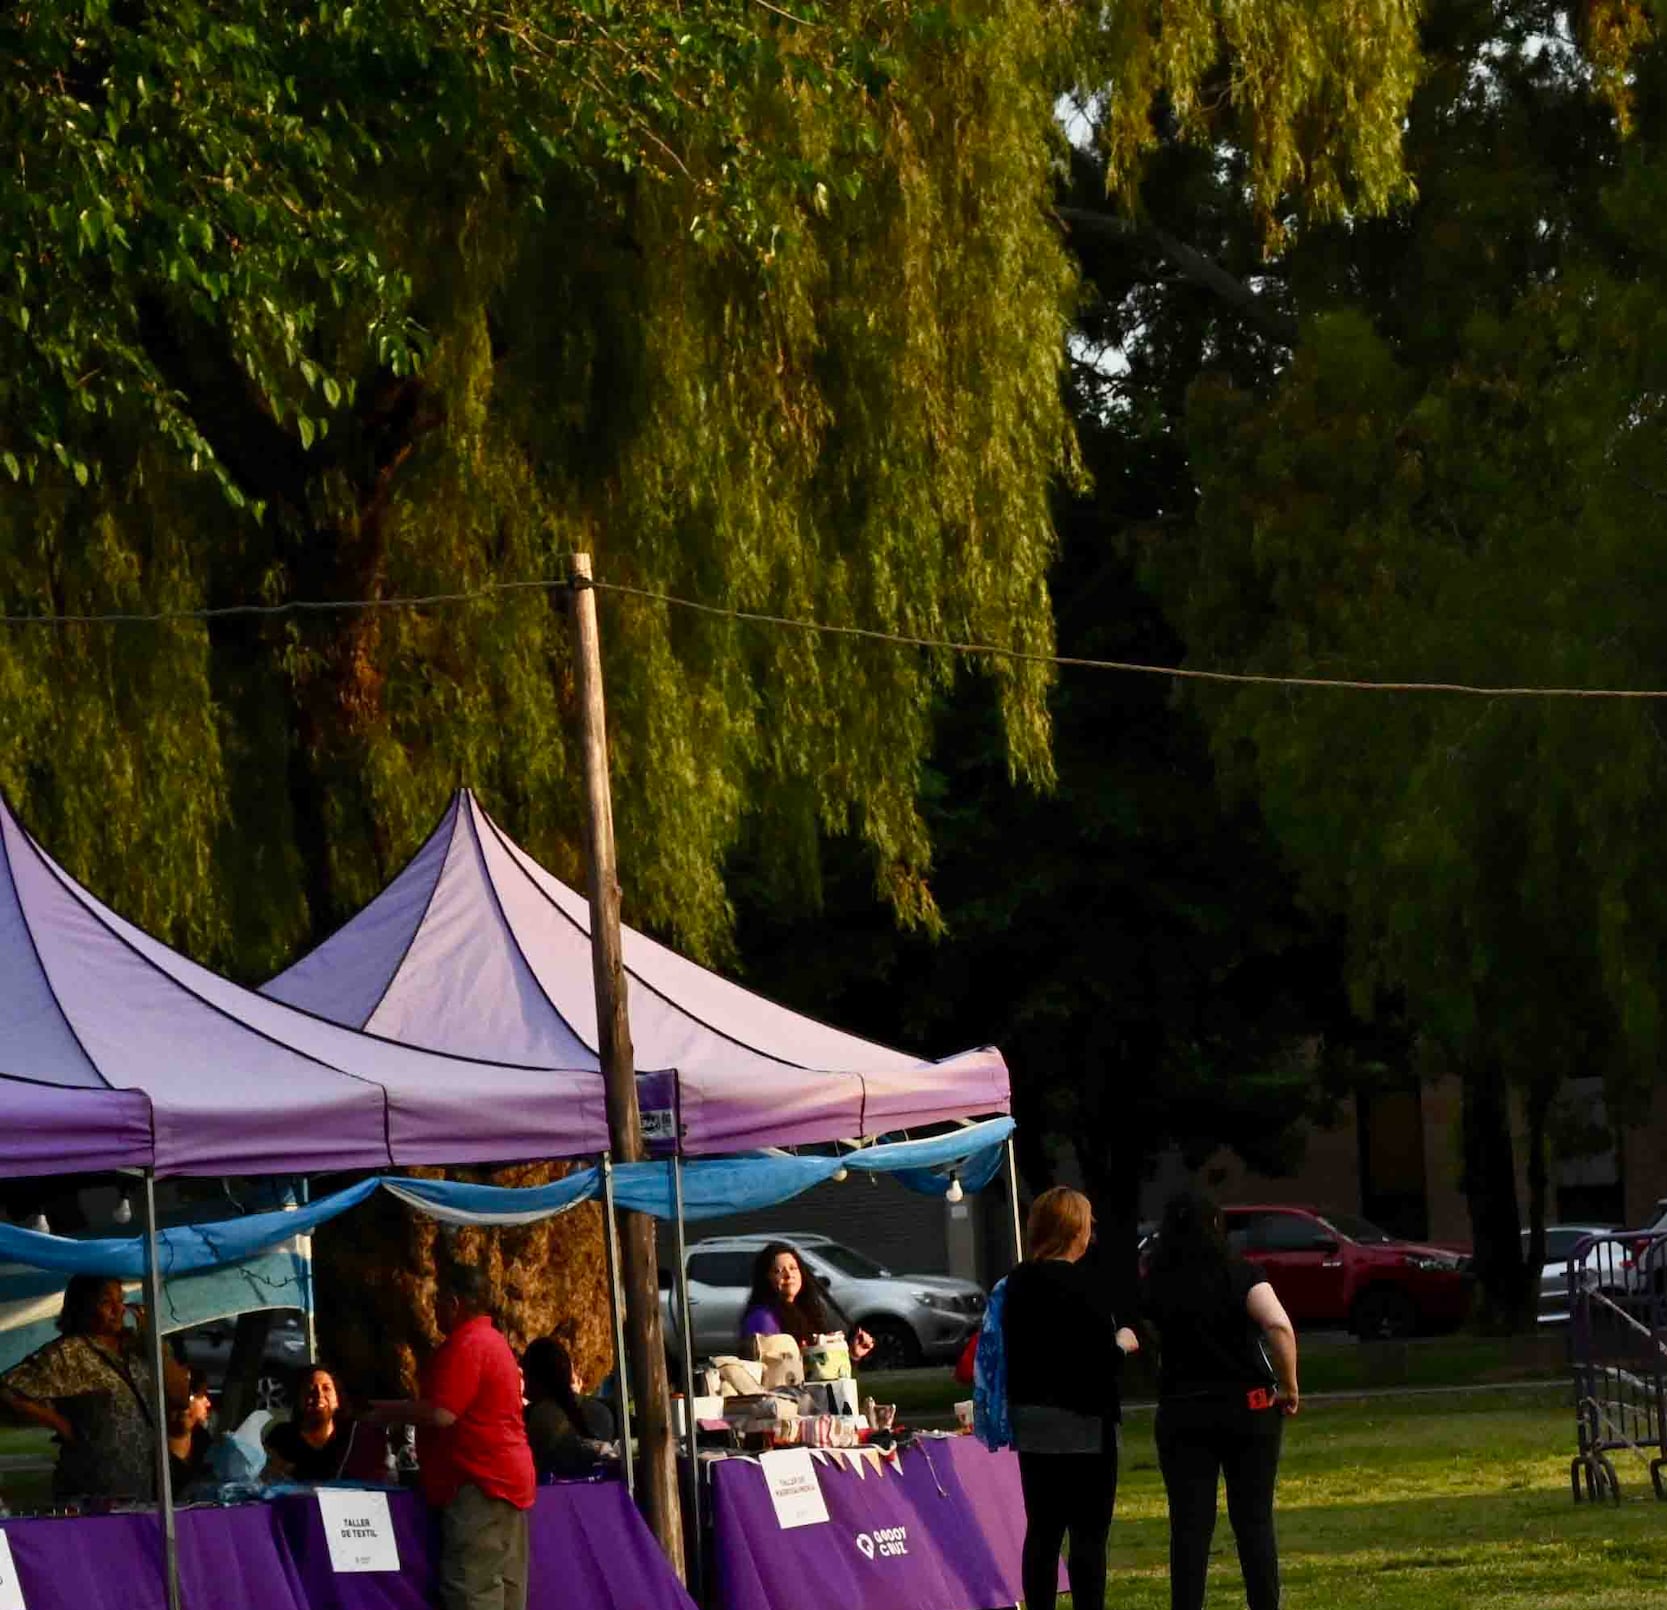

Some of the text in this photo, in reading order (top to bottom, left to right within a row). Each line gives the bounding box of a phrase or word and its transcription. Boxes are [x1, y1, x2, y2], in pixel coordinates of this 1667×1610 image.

[343, 1518, 370, 1528] TALLER
[873, 1526, 907, 1543] GODOY
[879, 1541, 909, 1557] CRUZ
